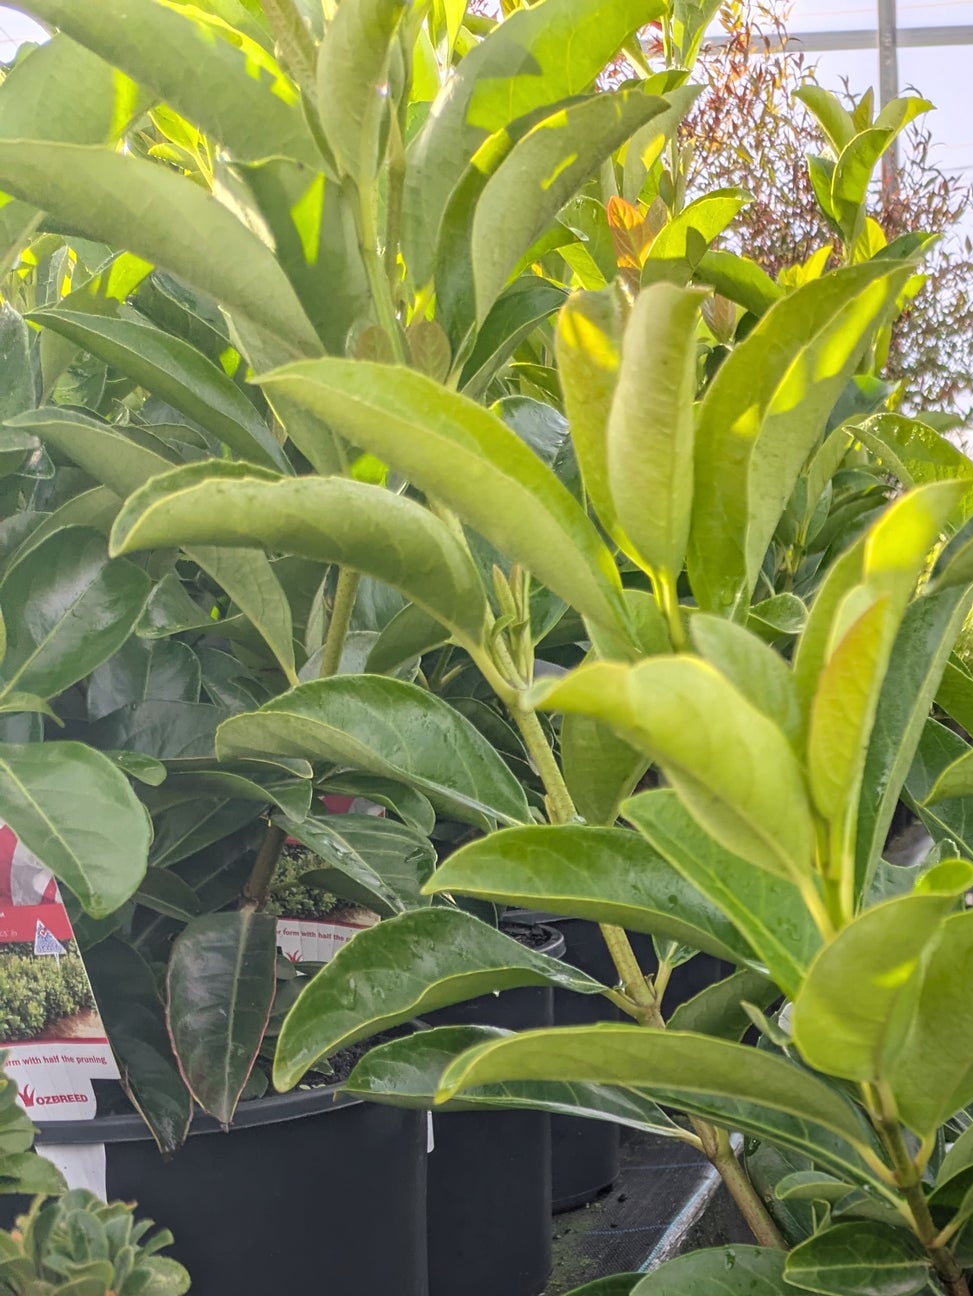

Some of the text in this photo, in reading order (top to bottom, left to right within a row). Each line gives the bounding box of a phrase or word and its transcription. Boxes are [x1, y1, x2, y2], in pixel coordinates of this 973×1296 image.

[22, 1057, 42, 1065] with
[43, 1055, 60, 1064] half
[60, 1055, 75, 1064] the
[76, 1056, 107, 1065] pruning
[36, 1094, 88, 1105] OZBREED
